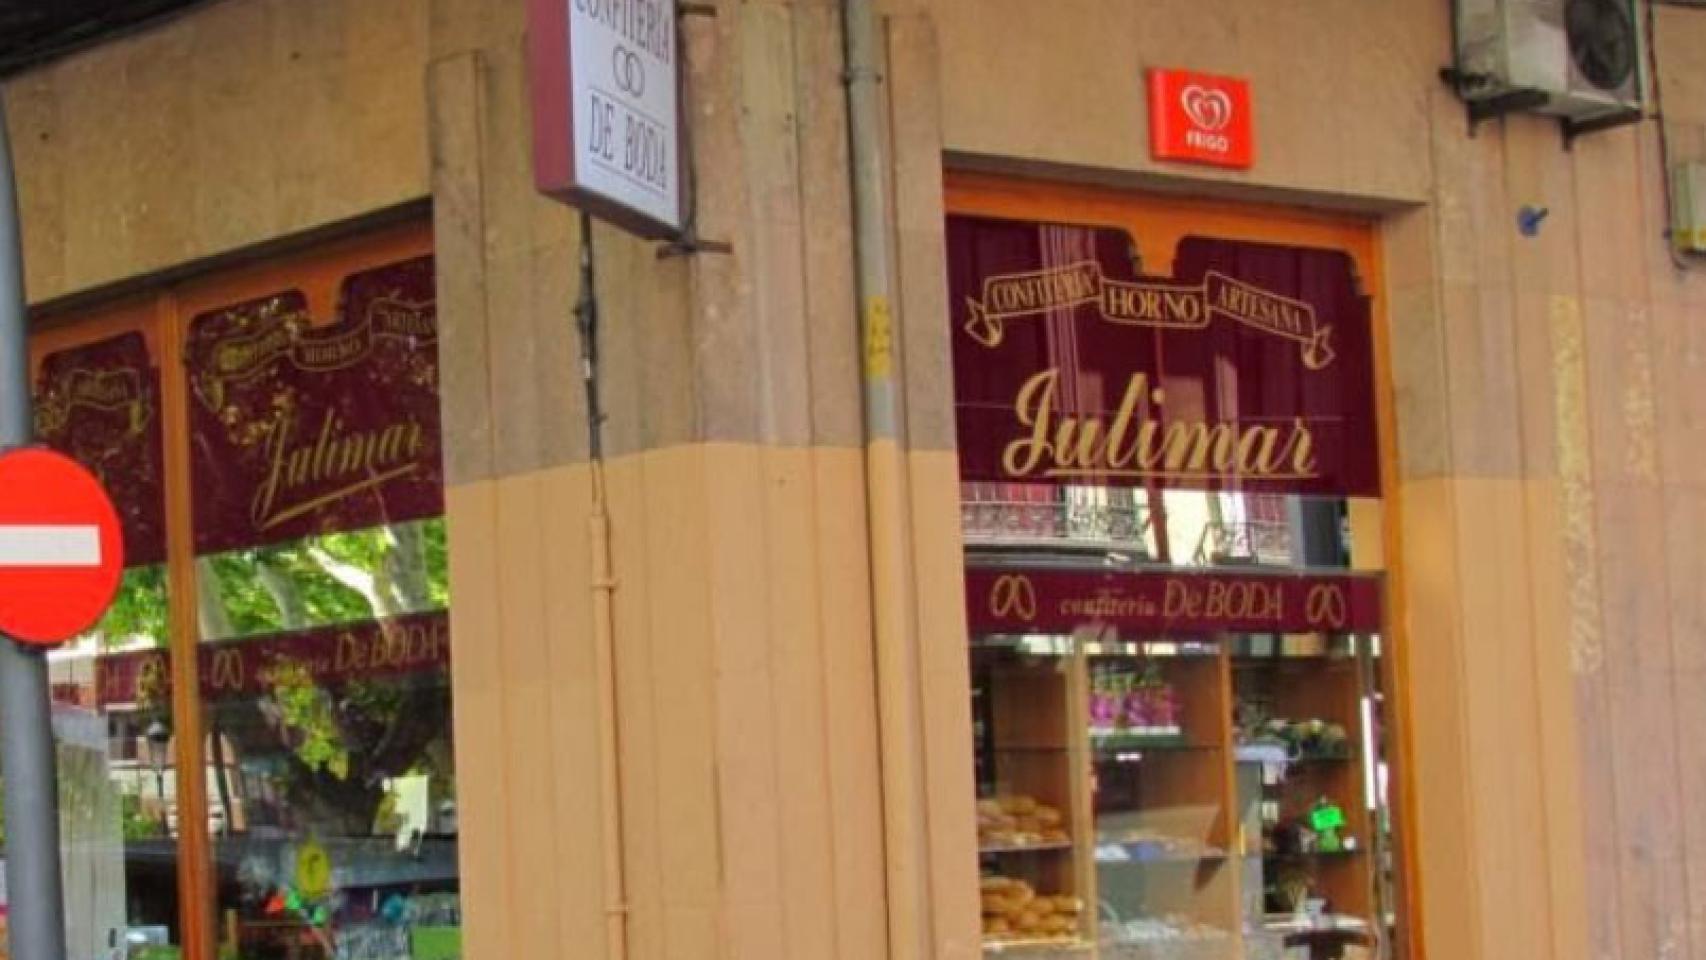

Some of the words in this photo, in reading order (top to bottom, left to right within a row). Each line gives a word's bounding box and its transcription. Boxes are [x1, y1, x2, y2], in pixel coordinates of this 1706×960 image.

[575, 0, 670, 64] FITERIA
[590, 93, 615, 161] DE
[624, 112, 667, 189] BODA
[1186, 129, 1228, 153] FRIGO
[1108, 286, 1200, 322] HORNO
[1219, 281, 1301, 333] ARTESANA
[1003, 366, 1317, 477] Julimar
[251, 406, 422, 530] Julimar
